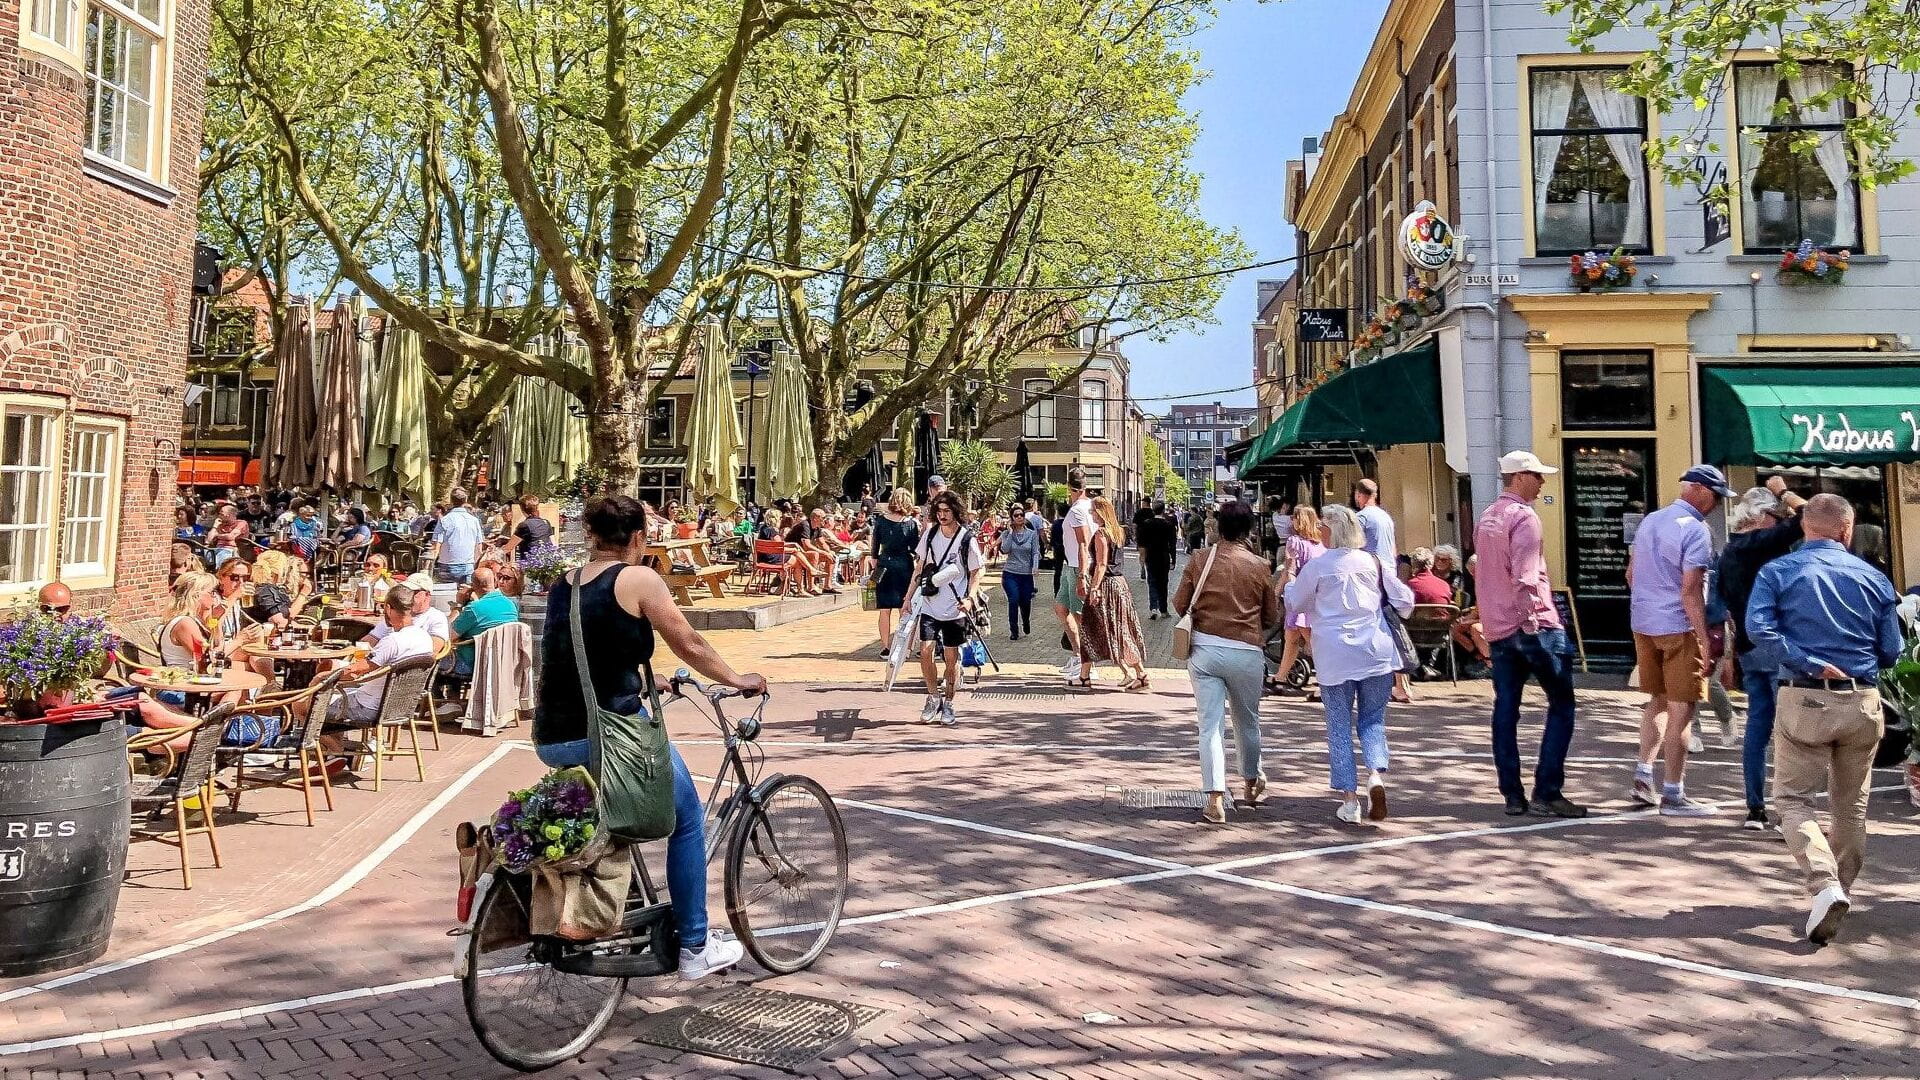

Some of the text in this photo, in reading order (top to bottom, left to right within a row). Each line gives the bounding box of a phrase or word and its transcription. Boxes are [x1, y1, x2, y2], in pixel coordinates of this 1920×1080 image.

[1302, 311, 1332, 325] Kobus
[1319, 325, 1344, 338] Kuch
[1792, 412, 1895, 453] Kobus
[6, 820, 77, 839] RES
